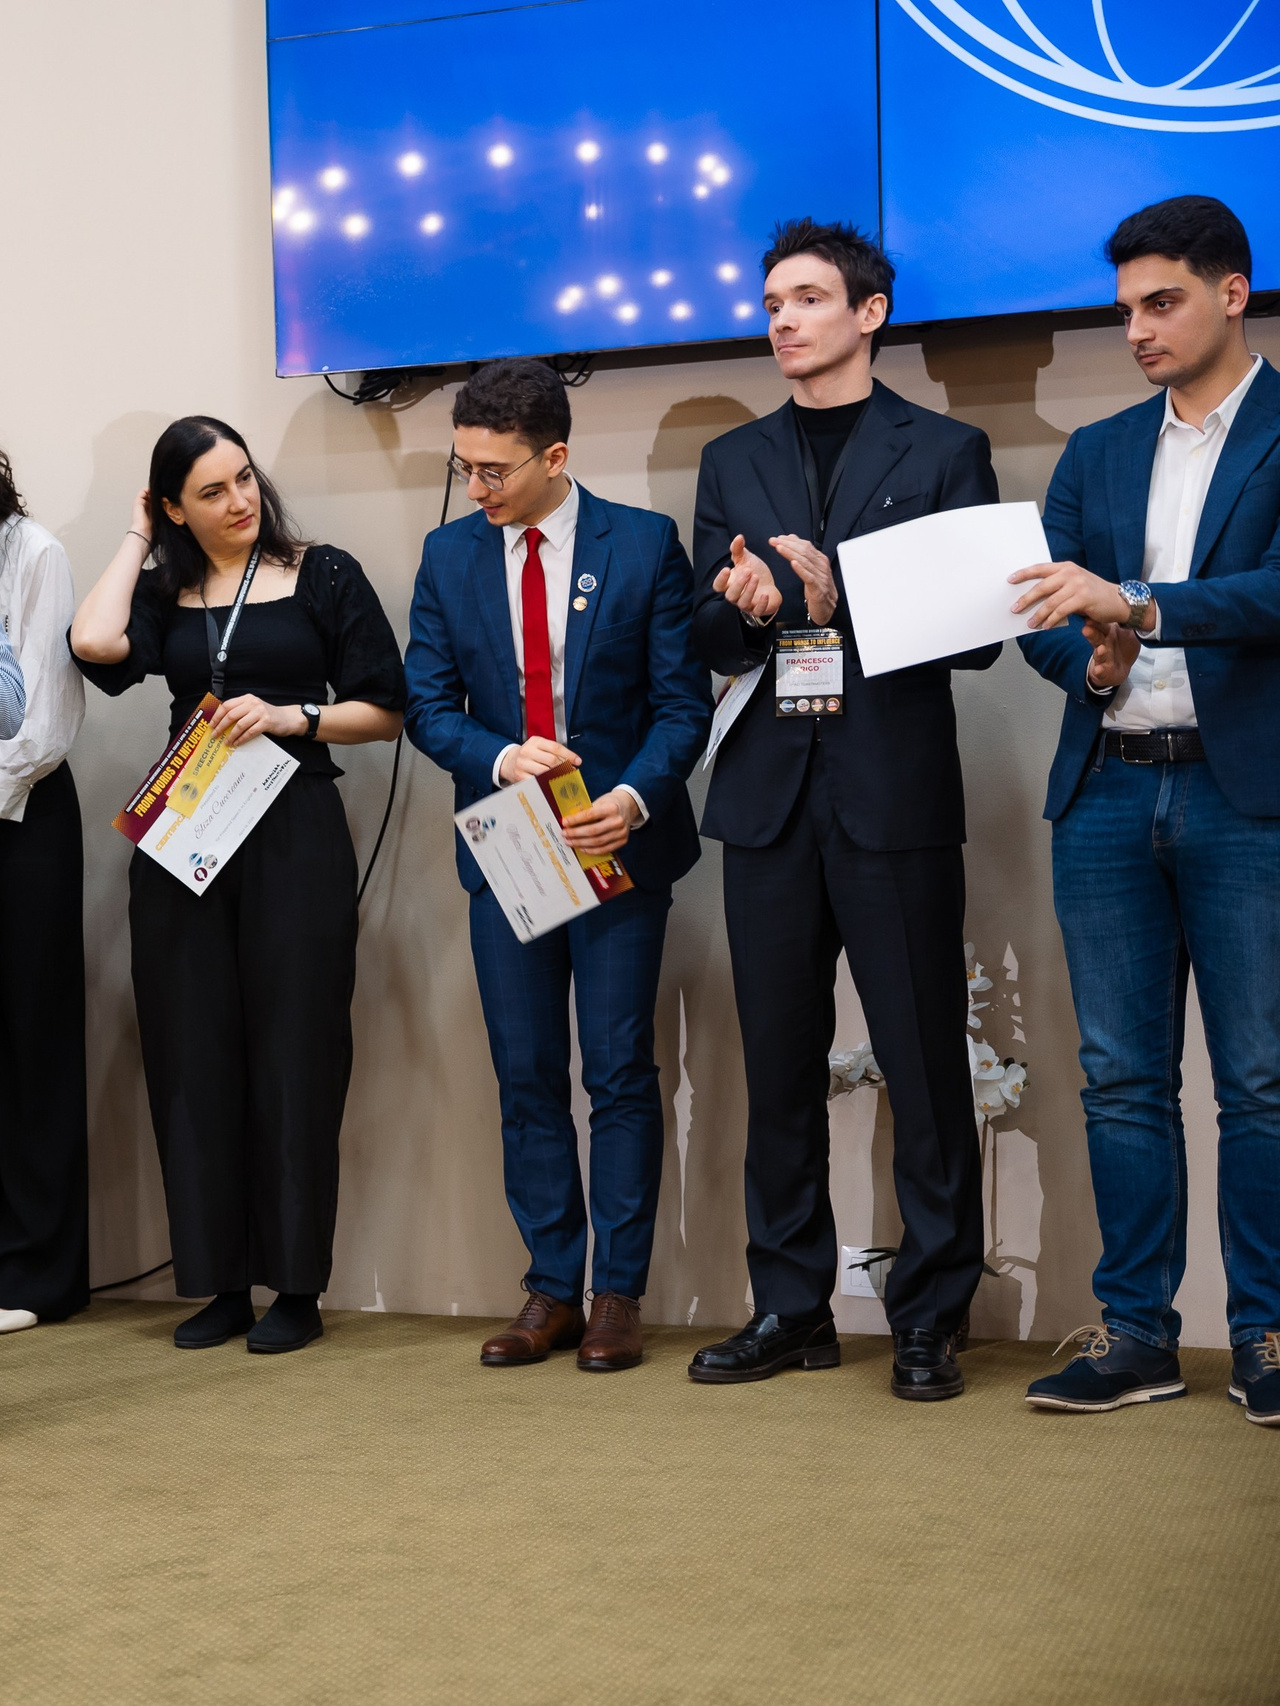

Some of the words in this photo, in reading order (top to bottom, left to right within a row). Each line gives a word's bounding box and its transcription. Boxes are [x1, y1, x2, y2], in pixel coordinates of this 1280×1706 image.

[786, 657, 833, 665] FRANCESCO
[133, 791, 156, 817] FROM
[150, 765, 176, 796] WORDS
[169, 754, 184, 769] TO
[177, 718, 210, 759] INFLUENCE
[192, 748, 210, 776] SPEECH
[154, 813, 185, 851] CERTIFIC
[190, 811, 214, 840] Eliza
